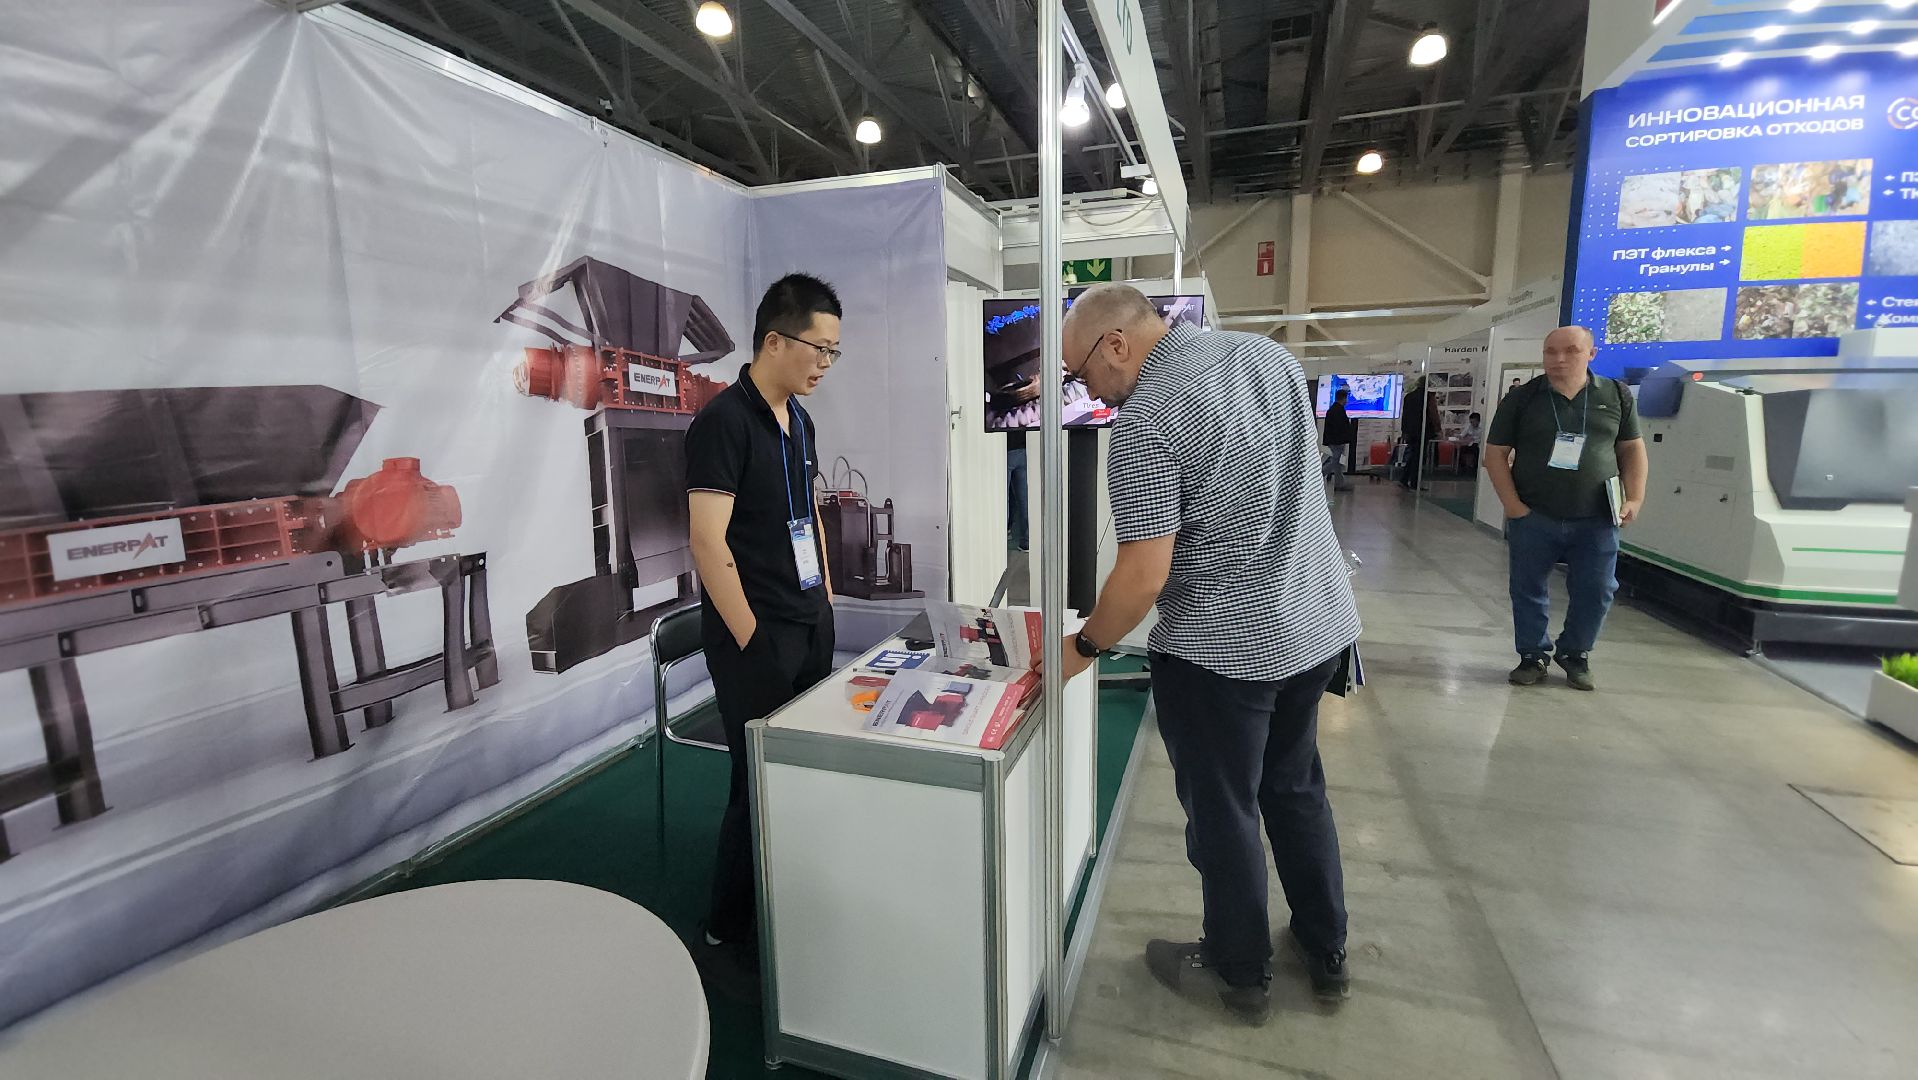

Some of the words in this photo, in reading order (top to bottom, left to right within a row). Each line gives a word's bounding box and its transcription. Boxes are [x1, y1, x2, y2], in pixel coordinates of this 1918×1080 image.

[1628, 94, 1865, 129] ИННОВАЦИОННАЯ
[1625, 125, 1763, 148] СОРТИРОВКА
[1766, 118, 1864, 135] ОТХОДОВ
[1612, 247, 1650, 261] ПЭТ
[1651, 246, 1717, 261] флекса
[1639, 262, 1715, 277] Гранулы
[633, 372, 671, 391] ENERPAT
[66, 531, 169, 561] ENERPAT
